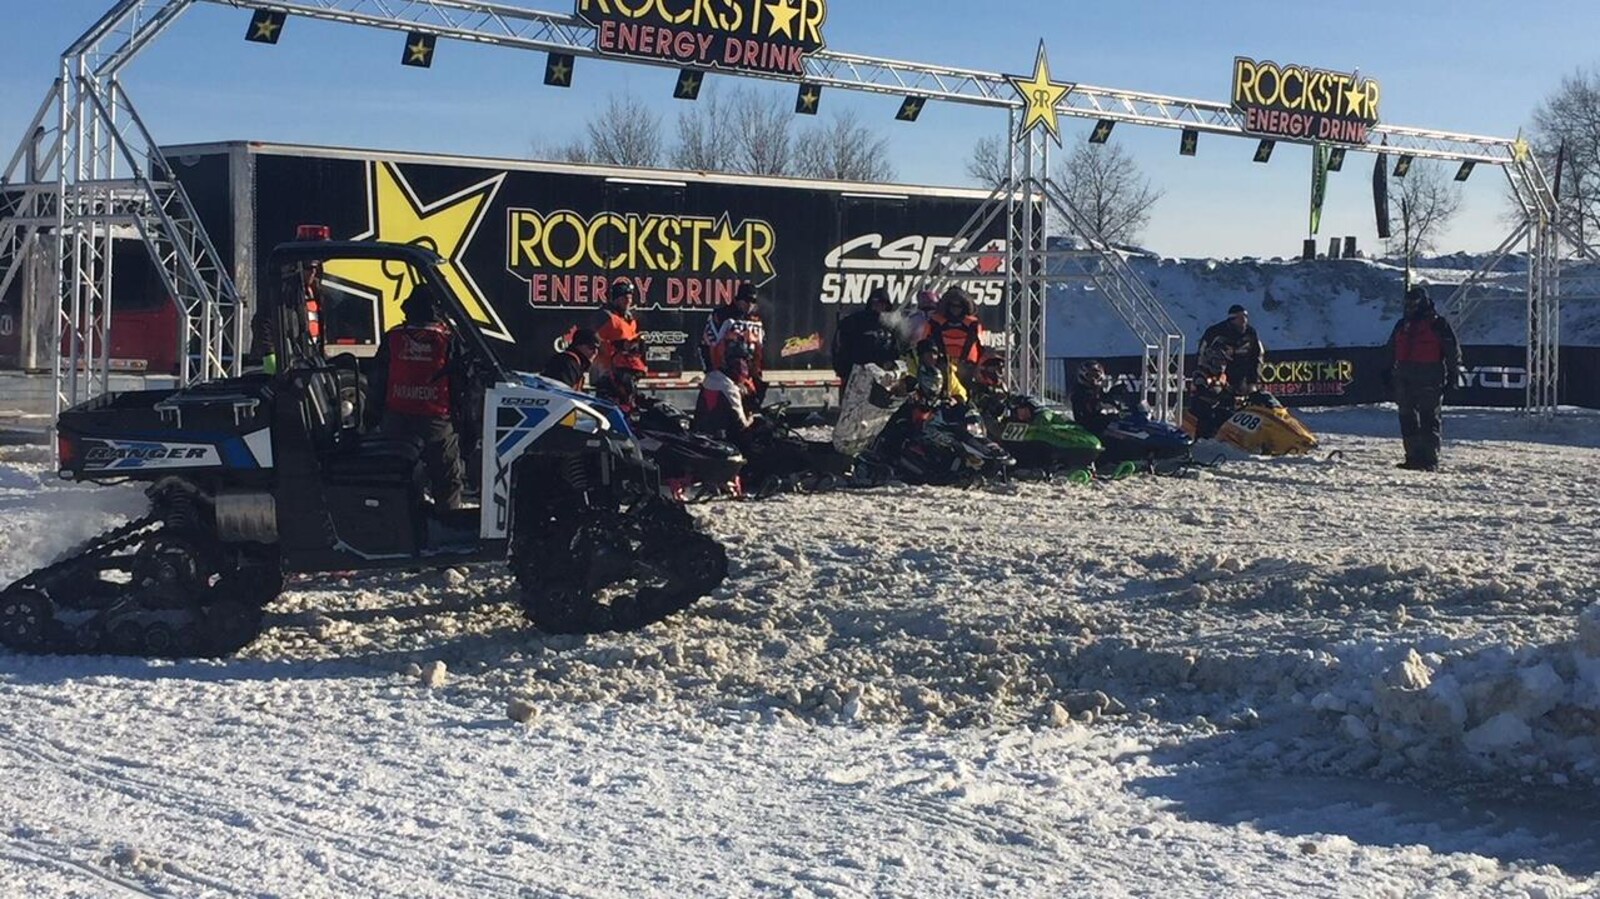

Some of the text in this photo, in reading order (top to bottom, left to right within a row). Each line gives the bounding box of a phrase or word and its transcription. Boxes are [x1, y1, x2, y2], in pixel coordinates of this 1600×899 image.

[581, 0, 824, 44] STAR
[601, 20, 804, 72] ENERGY DRINK
[1236, 61, 1379, 120] ROCKSTAR
[1247, 108, 1368, 143] ENERGY DRINK
[511, 212, 773, 274] ROCKSTAR
[533, 274, 653, 305] ENERY
[820, 272, 1005, 306] SNOWCSS
[1258, 361, 1354, 382] OCKSTAR
[501, 397, 550, 407] 1000
[1259, 383, 1302, 395] NERGY
[1233, 412, 1260, 430] 008
[85, 447, 208, 461] RANGER
